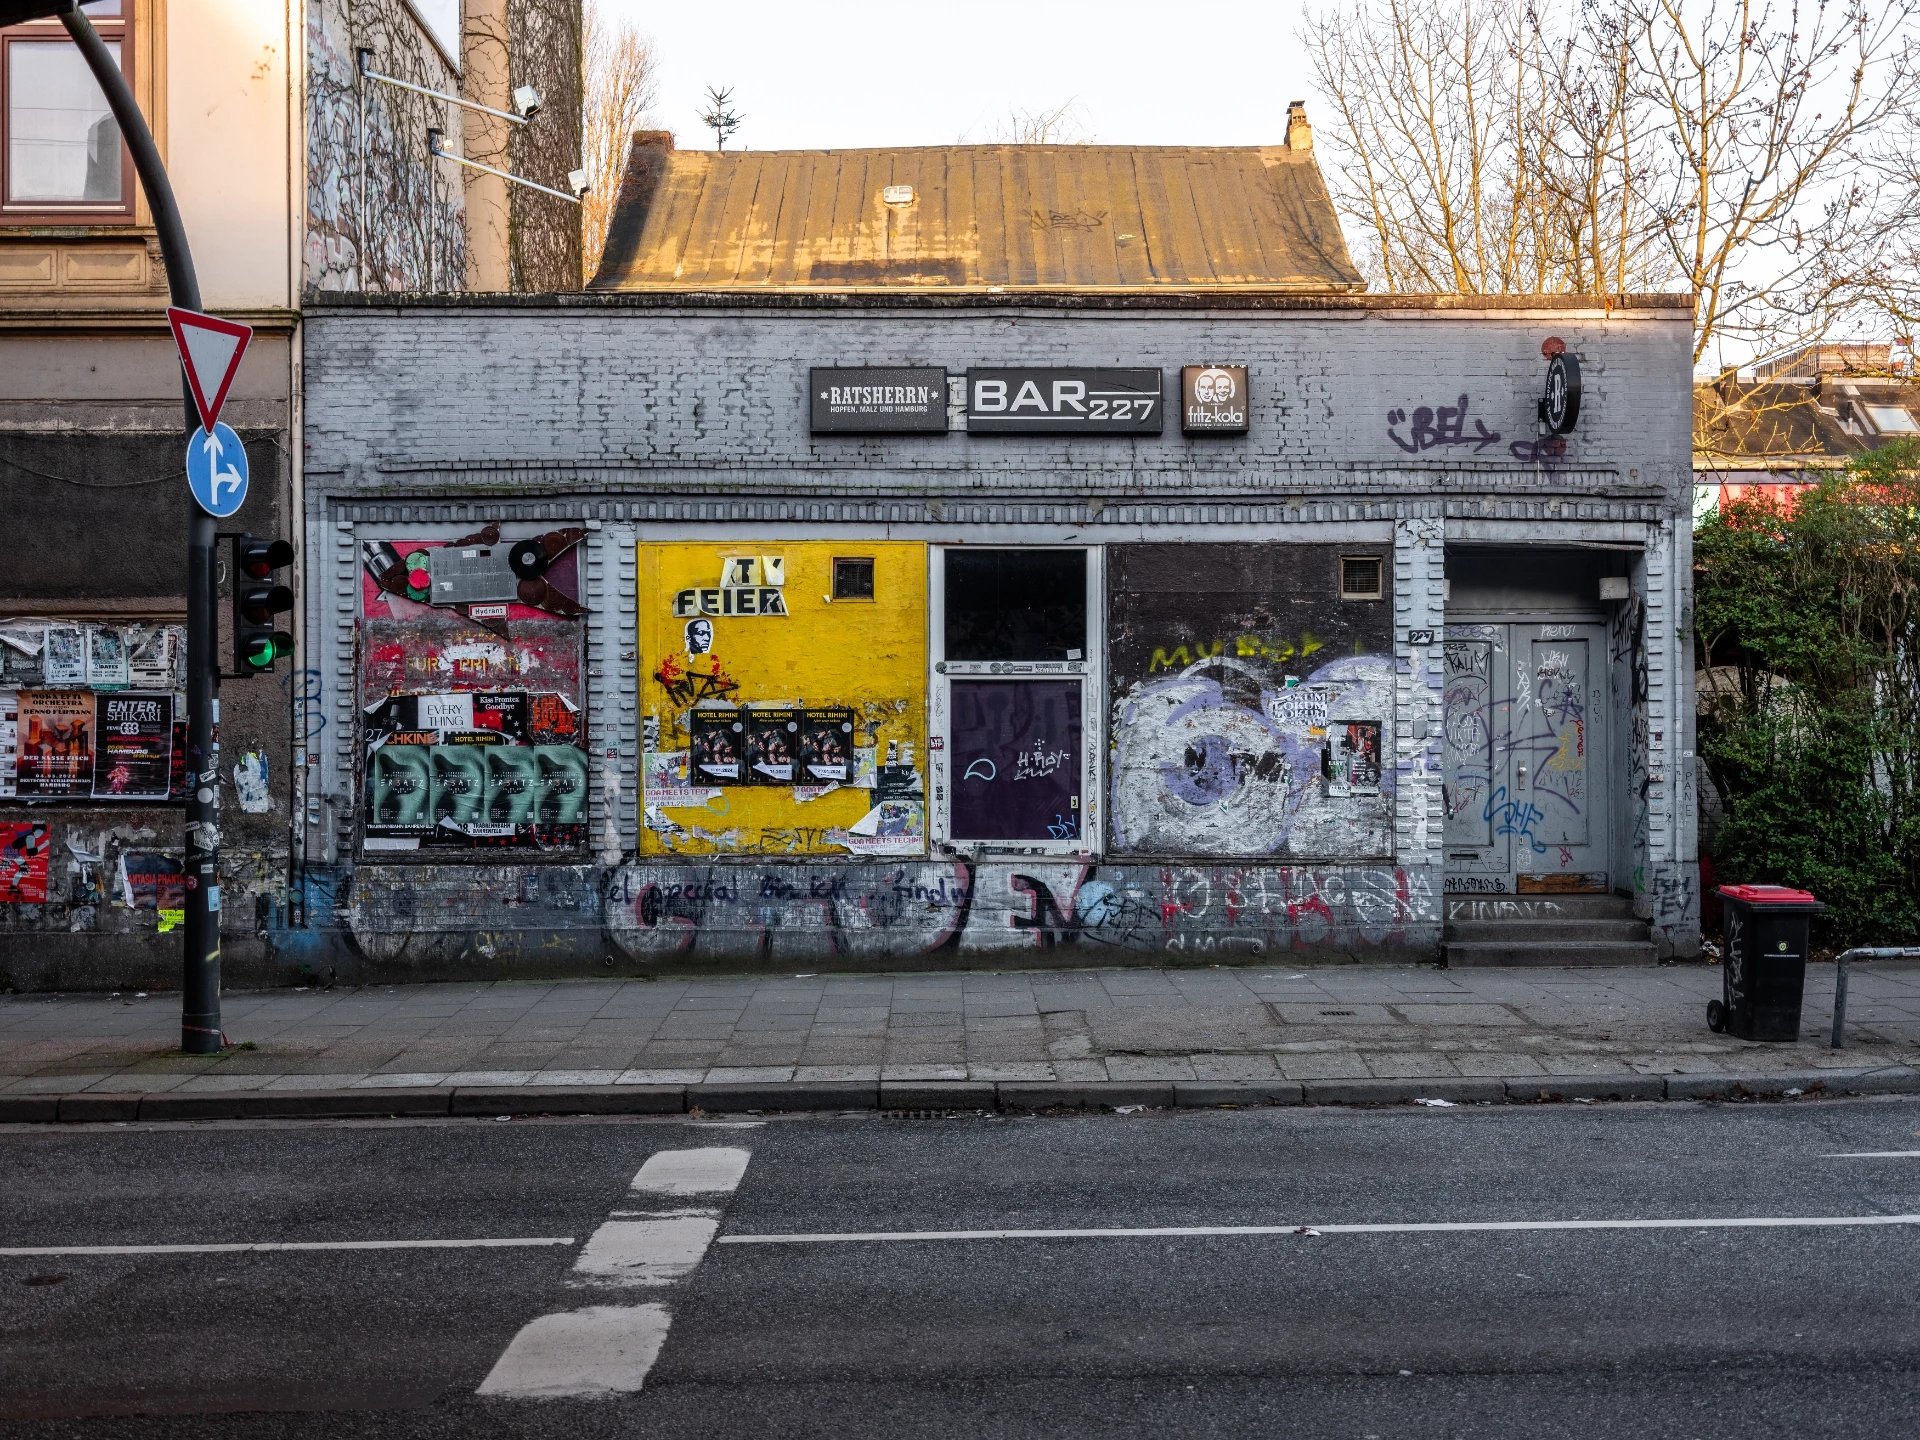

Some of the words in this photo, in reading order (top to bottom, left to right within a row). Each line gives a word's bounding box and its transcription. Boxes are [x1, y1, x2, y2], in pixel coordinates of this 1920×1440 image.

[830, 386, 929, 405] RATSHERRN
[973, 379, 1088, 412] BAR
[830, 405, 858, 414] HOPFEN,
[859, 405, 878, 413] MALZ
[879, 405, 894, 413] UND
[895, 405, 928, 413] HAMBURG
[1088, 398, 1155, 420] 227
[1187, 405, 1243, 423] fritz-kola
[474, 606, 504, 616] Hydrant
[1410, 631, 1433, 644] 227
[479, 696, 494, 704] Kiss
[494, 695, 520, 703] Frontex
[485, 703, 515, 711] Goodbye
[107, 711, 162, 721] SHIKARI
[427, 715, 465, 727] THING
[848, 837, 865, 845] GOA
[865, 837, 892, 845] MEETS
[893, 836, 924, 844] TECHNO
